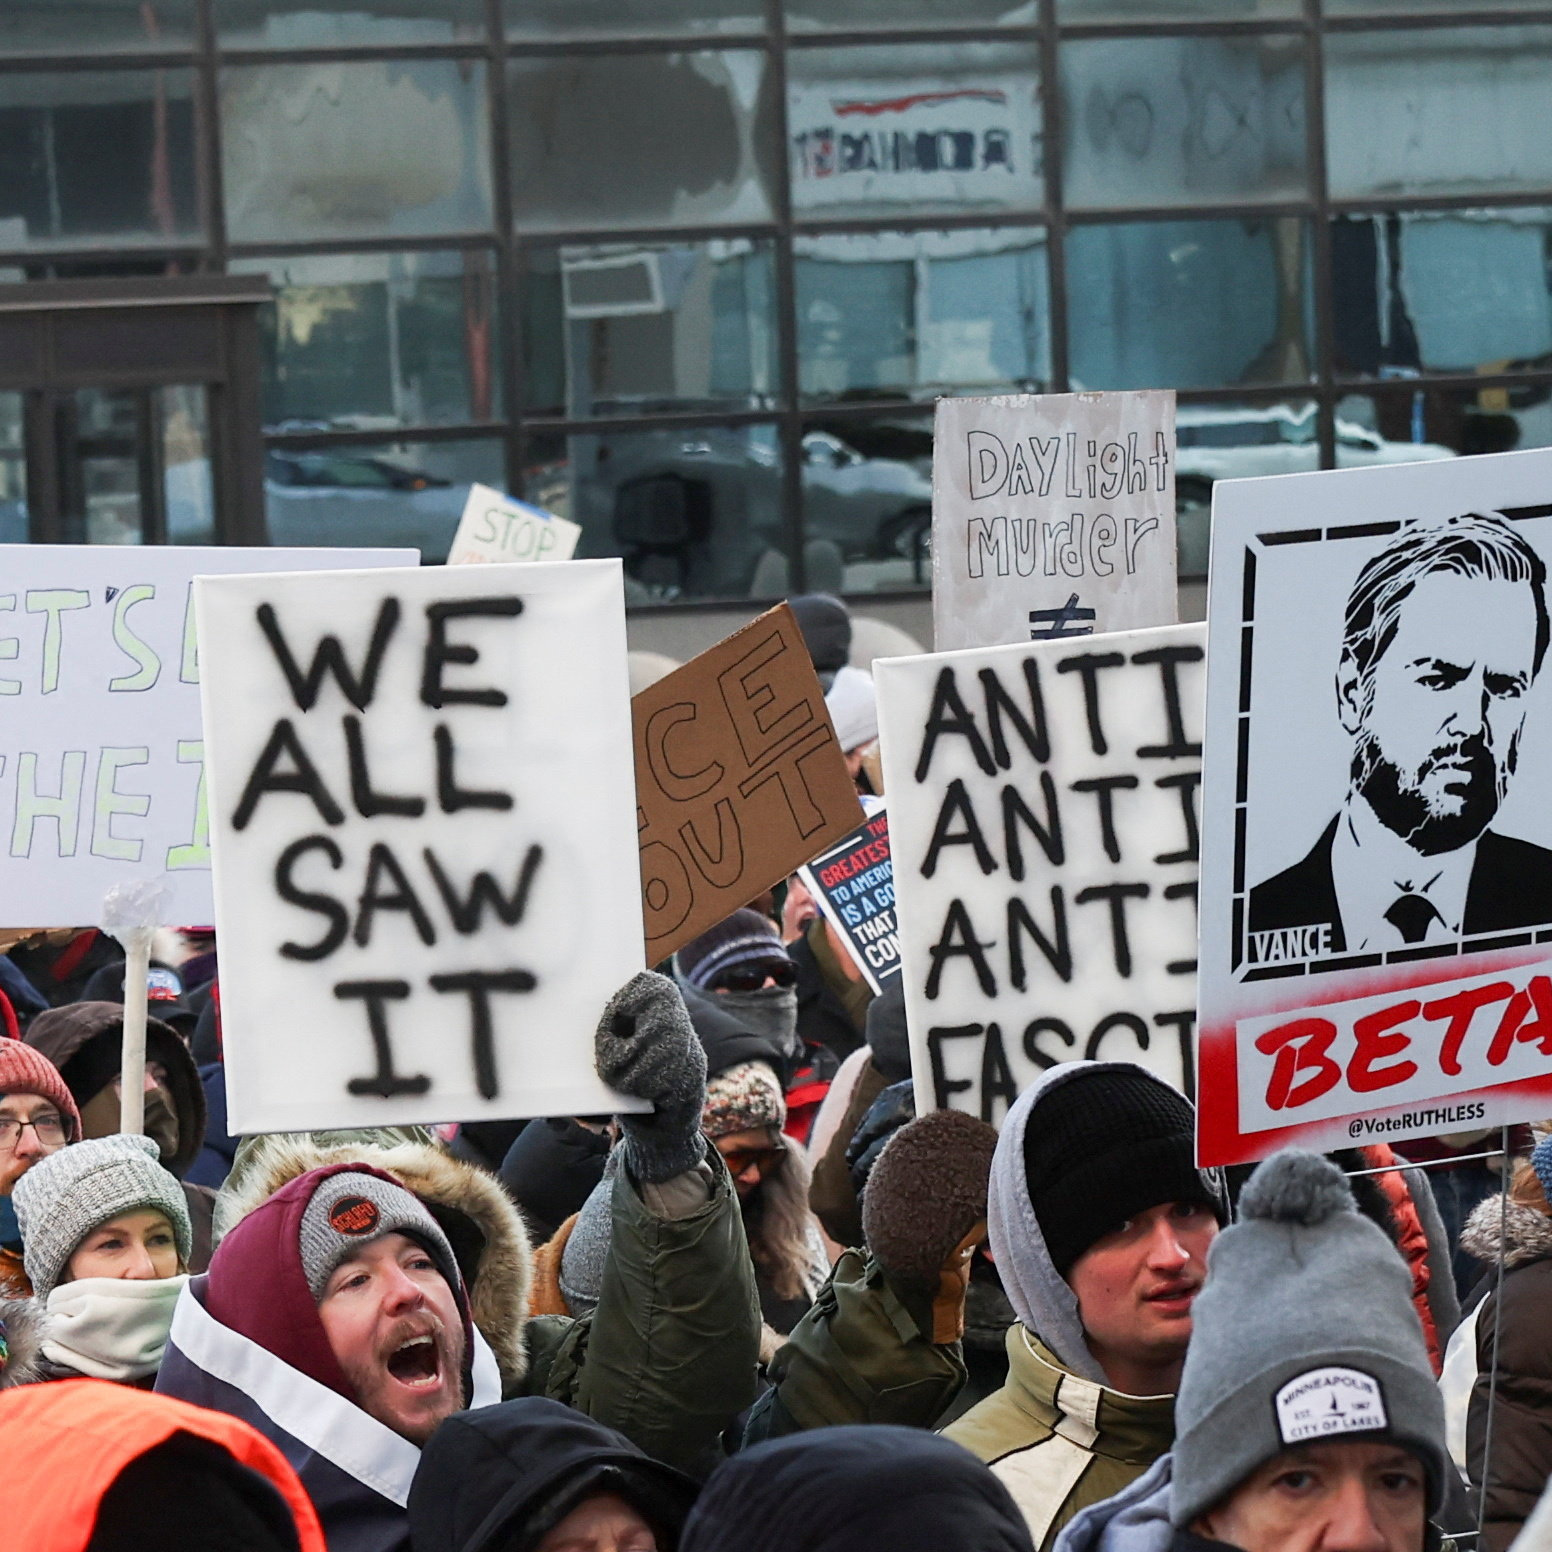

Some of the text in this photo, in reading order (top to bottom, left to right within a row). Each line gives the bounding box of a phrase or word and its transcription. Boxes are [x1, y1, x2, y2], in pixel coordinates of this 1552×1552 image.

[474, 508, 558, 561] STOP
[967, 513, 1159, 578] Murder
[256, 595, 524, 711] WE
[637, 630, 814, 834] CE
[914, 646, 1204, 783] ANTI
[231, 715, 514, 831] ALL
[639, 722, 832, 940] OUT
[920, 770, 1201, 882] ANTI
[275, 835, 544, 961] SAW
[829, 886, 850, 905] TO
[841, 905, 862, 926] IS
[862, 897, 876, 917] A
[853, 910, 895, 944] THAT
[1253, 922, 1332, 963] VANCE
[333, 971, 539, 1099] IT
[1348, 1102, 1485, 1138] @VoteRUTHLESS
[1290, 1424, 1317, 1438] CITY
[1322, 1420, 1338, 1431] OF
